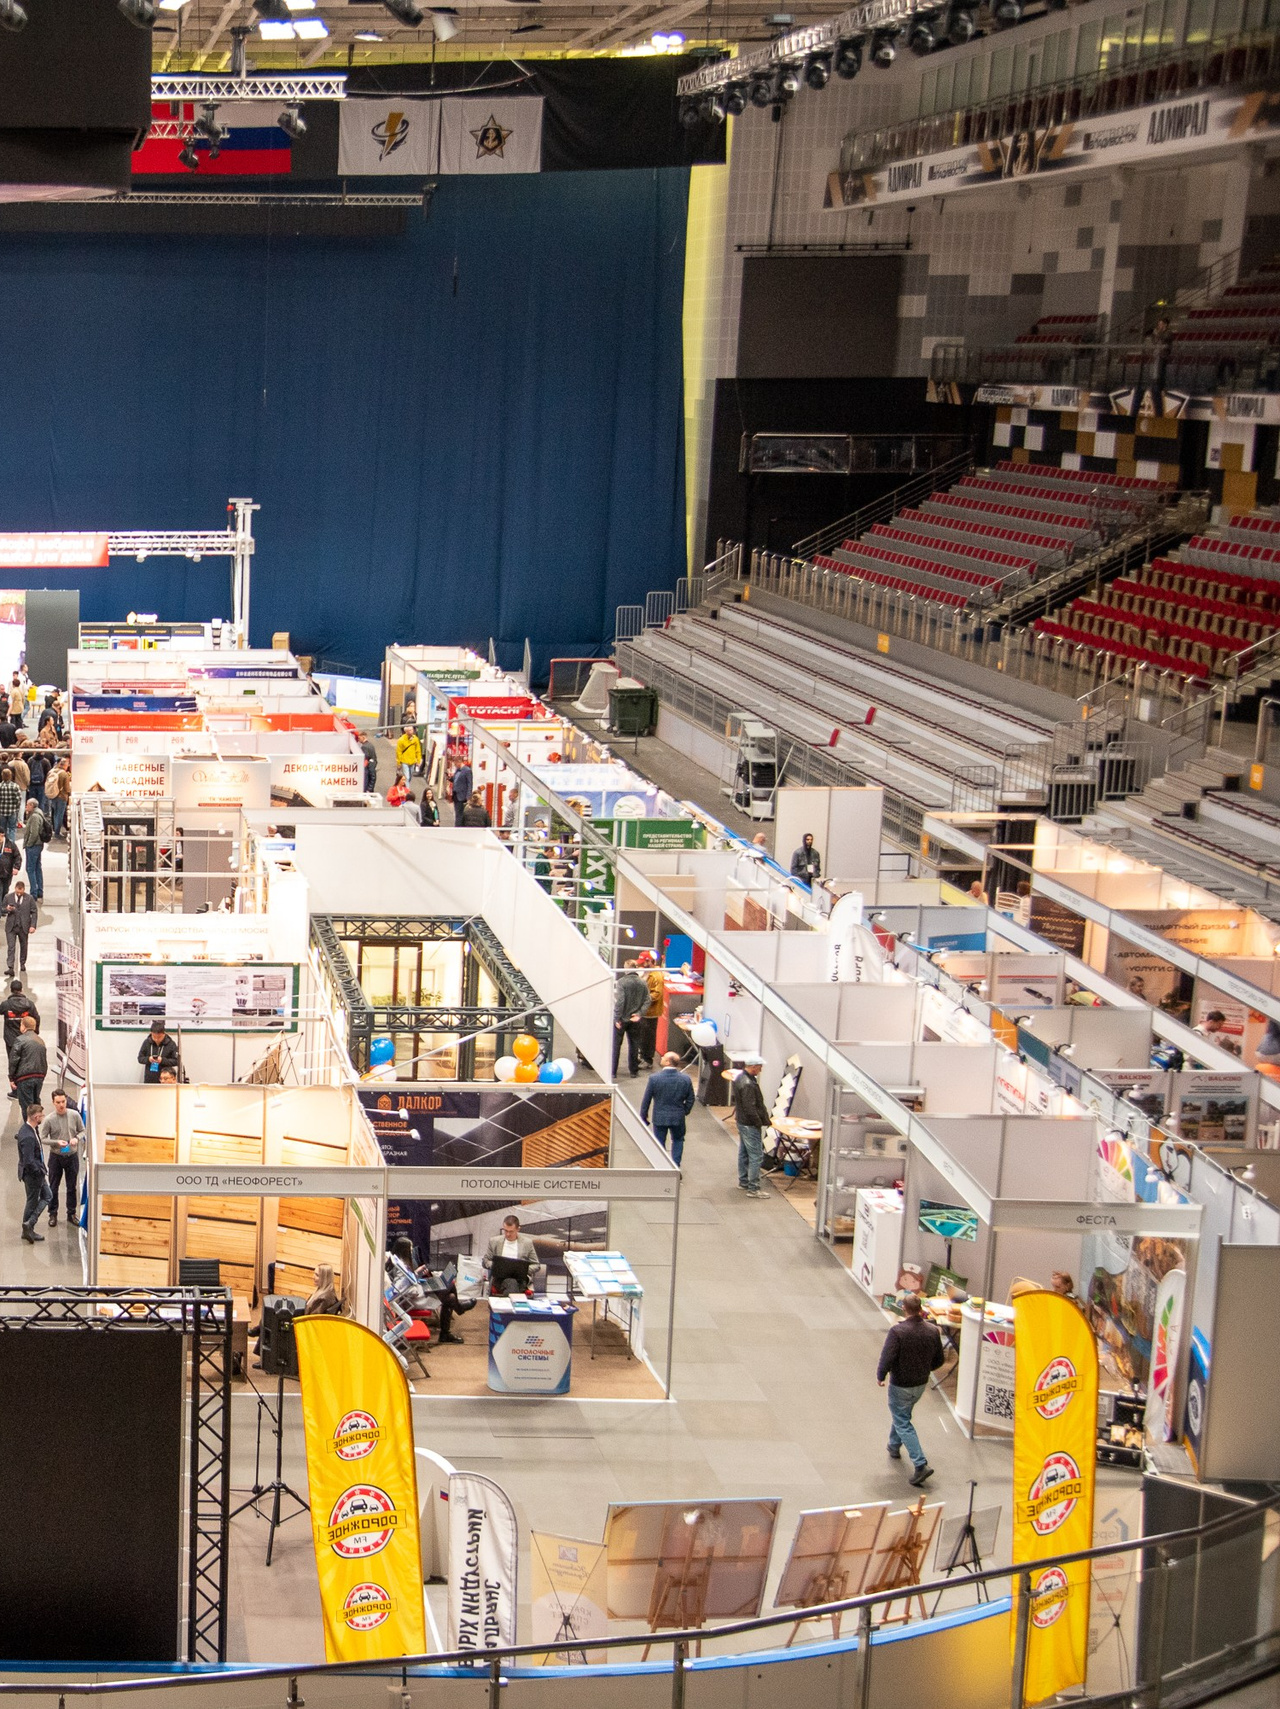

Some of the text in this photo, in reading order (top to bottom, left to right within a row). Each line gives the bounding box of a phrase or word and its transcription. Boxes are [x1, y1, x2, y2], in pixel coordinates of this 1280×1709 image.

[1146, 100, 1210, 145] АДМИРАЛ
[887, 162, 922, 193] АДМИРАЛ
[34, 552, 59, 564] для
[470, 705, 521, 715] TOTACHI
[115, 763, 165, 772] НАВЕСНЫЕ
[283, 762, 358, 774] ДЕКОРАТИВНЫЙ
[112, 777, 165, 786] ФАСАДНЫЕ
[321, 777, 358, 786] КАМЕНЬ
[120, 789, 165, 797] СИСТЕМЫ
[397, 1095, 442, 1110] ДАЛКОР
[176, 1175, 304, 1187] ООО ТД «НЕОФОРЕСТ»
[460, 1179, 601, 1191] ПОТОЛОЧНЫЕ СИСТЕМЫ
[1076, 1214, 1117, 1225] ФЕСТА
